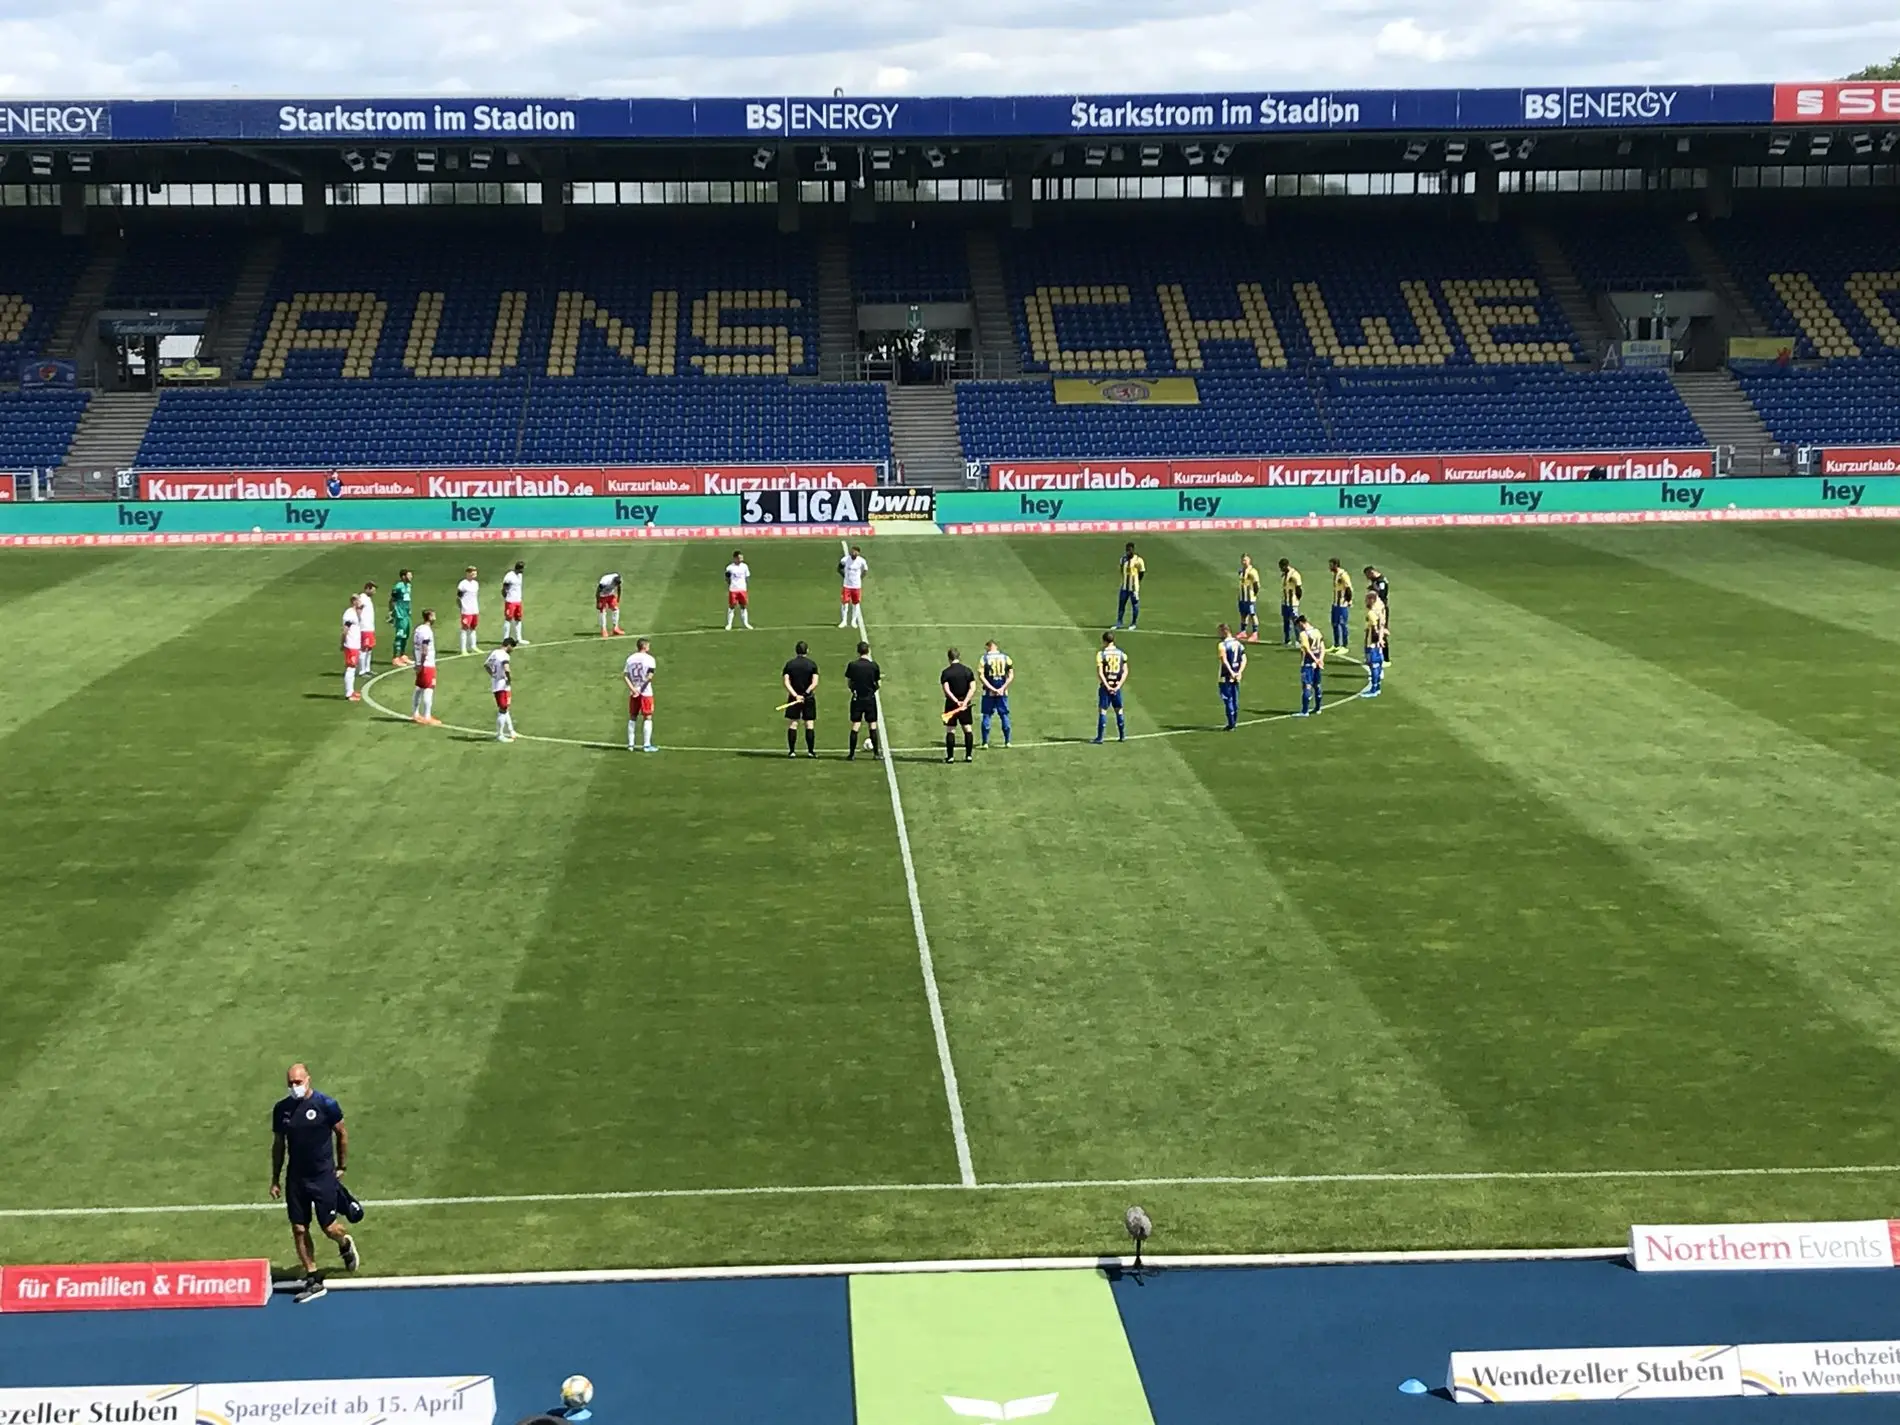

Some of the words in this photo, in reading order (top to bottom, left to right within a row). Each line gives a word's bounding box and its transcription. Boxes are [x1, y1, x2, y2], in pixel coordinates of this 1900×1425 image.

[279, 105, 426, 131] Starkstrom
[434, 105, 466, 130] im
[473, 105, 575, 131] Stadion
[746, 104, 783, 129] BS
[791, 104, 899, 129] ENERGY
[1071, 100, 1213, 127] Starkstrom
[1222, 99, 1252, 125] im
[1260, 96, 1359, 124] Stadion
[1525, 94, 1561, 119] BS
[1569, 91, 1677, 118] ENERGY
[117, 472, 132, 486] 13
[704, 472, 867, 494] Kurzurlaubd
[967, 464, 980, 477] 12
[999, 467, 1160, 490] Kurzurlaub.de
[1268, 463, 1430, 485] Kurzurlaub.de
[148, 477, 316, 500] Kurzurlaub.de
[341, 482, 414, 495] urzurlaub.de
[428, 474, 594, 497] Kurzurlaub.de
[608, 478, 690, 492] Kurzurlaub.de
[1501, 485, 1543, 511] hey
[1662, 482, 1704, 508] hey
[1822, 479, 1865, 505] hey
[616, 499, 658, 526] hey
[743, 492, 773, 522] 3.
[780, 490, 858, 522] LIGA
[868, 488, 931, 512] bwin
[1021, 494, 1063, 519] hey
[1179, 491, 1221, 517] hey
[1339, 488, 1382, 514] hey
[118, 504, 163, 530] hey
[286, 503, 330, 529] hey
[452, 501, 495, 527] hey
[1645, 1234, 1792, 1262] Northern
[1799, 1235, 1882, 1259] Events
[18, 1278, 50, 1299] für
[56, 1276, 146, 1298] Familien
[153, 1275, 170, 1296] &
[177, 1274, 250, 1295] Firmen
[1472, 1362, 1628, 1387] Wendezeller
[1637, 1359, 1724, 1384] Stuben
[1779, 1370, 1797, 1388] in
[88, 1400, 178, 1423] Stuben
[224, 1397, 337, 1422] Spargelzeit
[345, 1395, 368, 1415] ab
[379, 1396, 407, 1413] 15.
[414, 1391, 464, 1417] April
